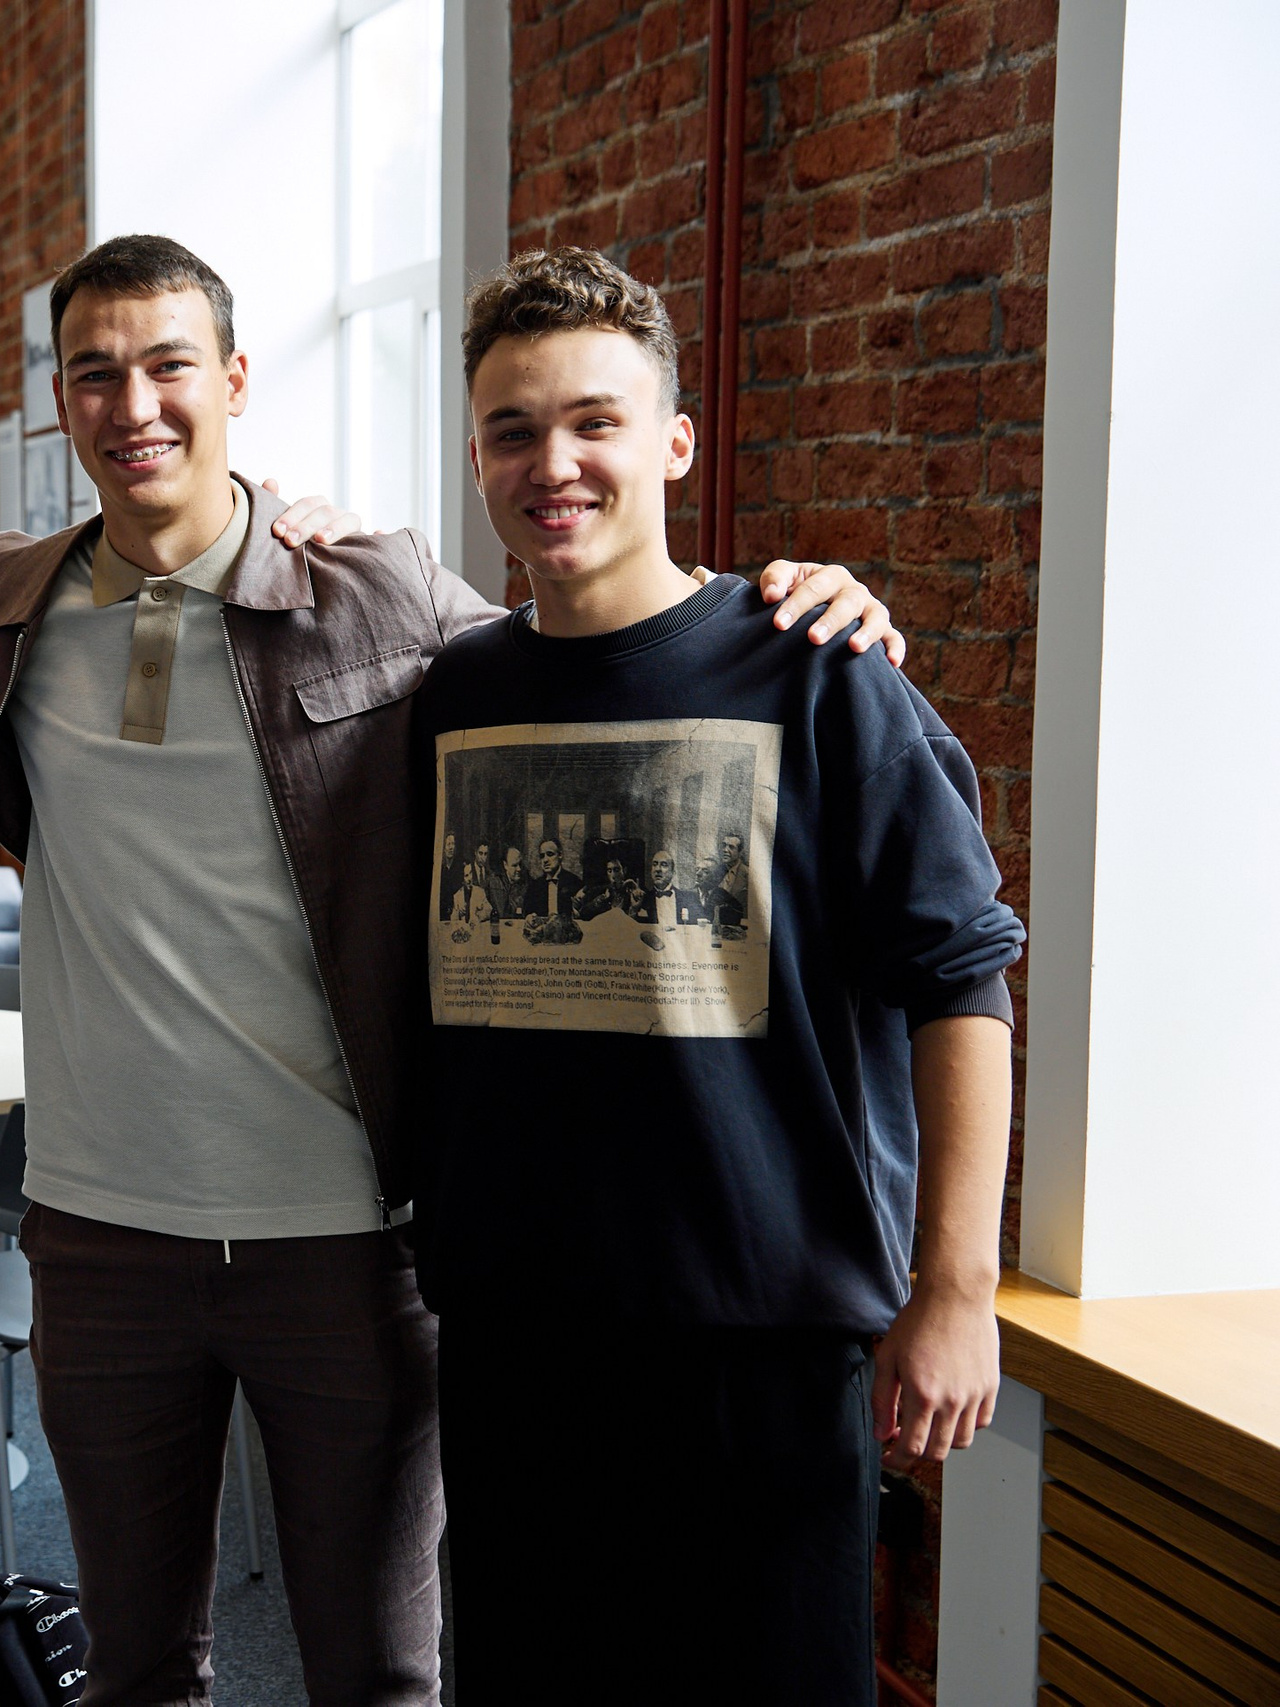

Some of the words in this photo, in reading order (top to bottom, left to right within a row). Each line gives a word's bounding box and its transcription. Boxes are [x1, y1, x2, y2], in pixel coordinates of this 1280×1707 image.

[539, 957, 560, 965] bread
[561, 957, 569, 965] at
[570, 957, 583, 965] the
[584, 958, 607, 966] same
[608, 958, 624, 967] time
[624, 959, 632, 967] to
[730, 963, 740, 971] is
[658, 972, 696, 982] Soprano
[544, 979, 563, 987] John
[610, 980, 631, 990] Frank
[677, 985, 685, 993] of
[687, 985, 705, 994] New
[515, 1001, 534, 1010] dons!
[581, 992, 611, 1001] Vincent
[704, 996, 727, 1006] Show
